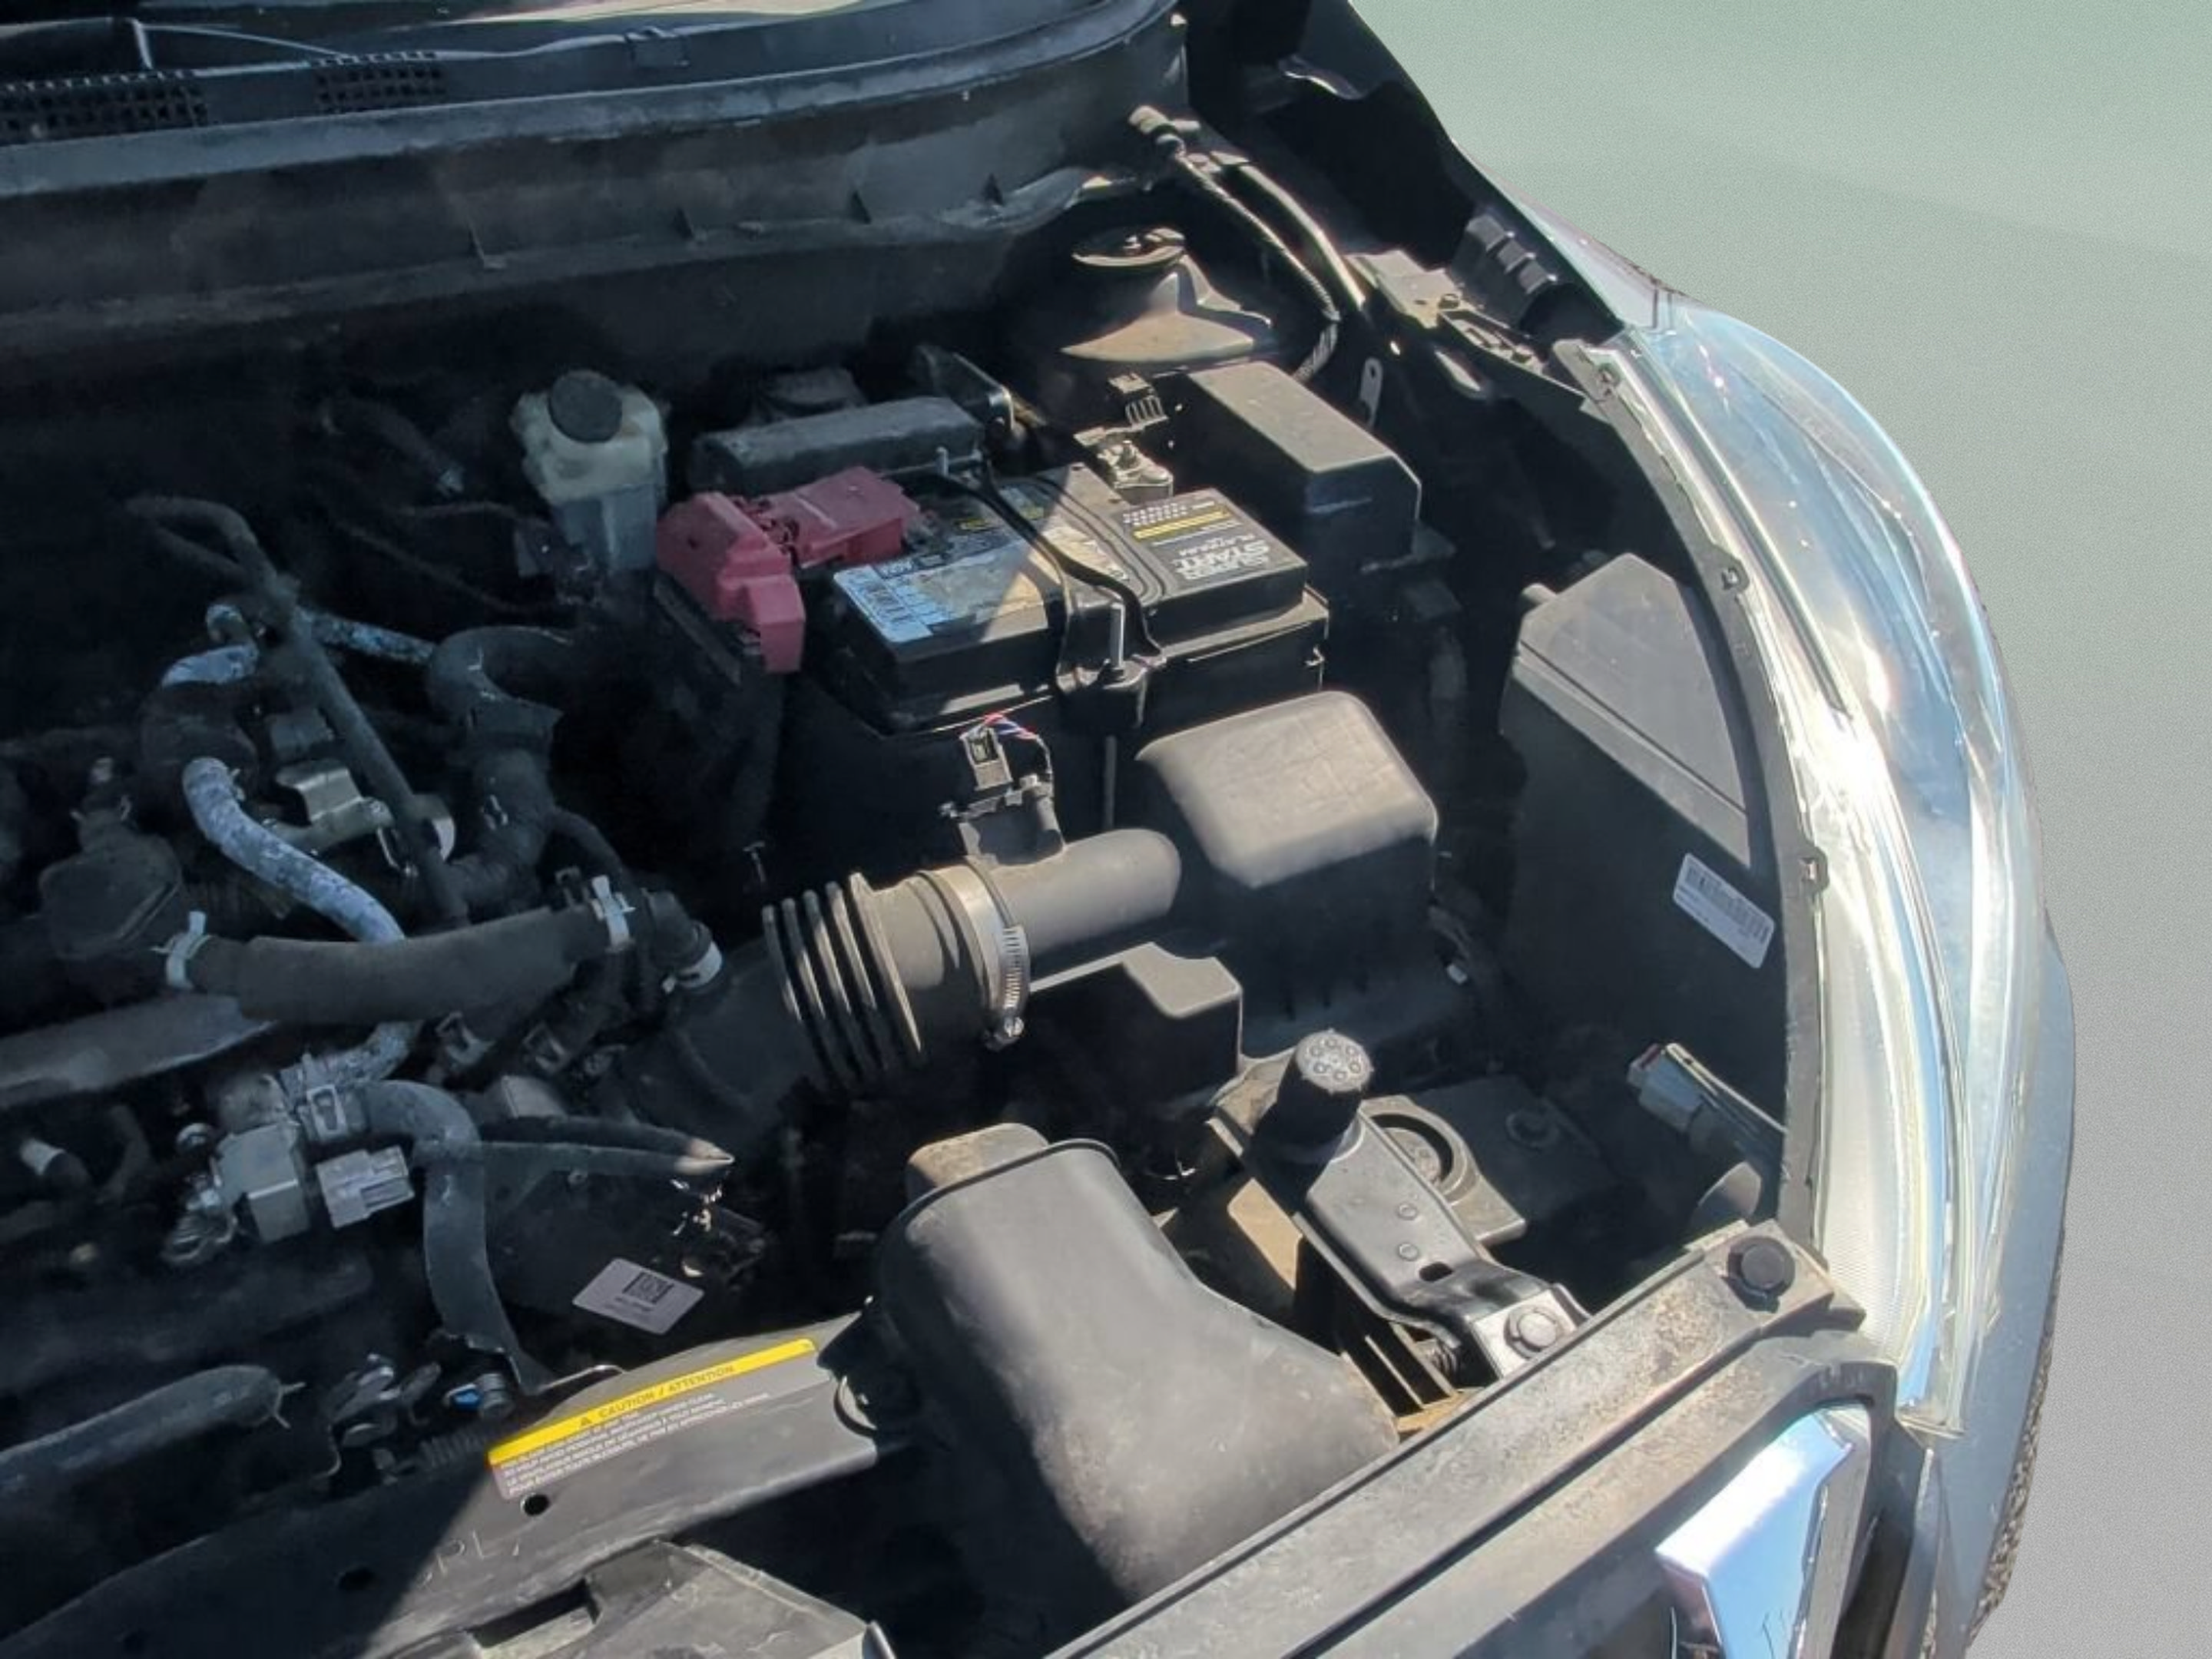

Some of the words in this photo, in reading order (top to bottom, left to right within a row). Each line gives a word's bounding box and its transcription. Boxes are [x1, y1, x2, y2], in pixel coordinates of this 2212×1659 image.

[1172, 539, 1270, 572] START
[598, 1391, 654, 1419] CAUTION
[668, 1365, 733, 1392] ATTENTION
